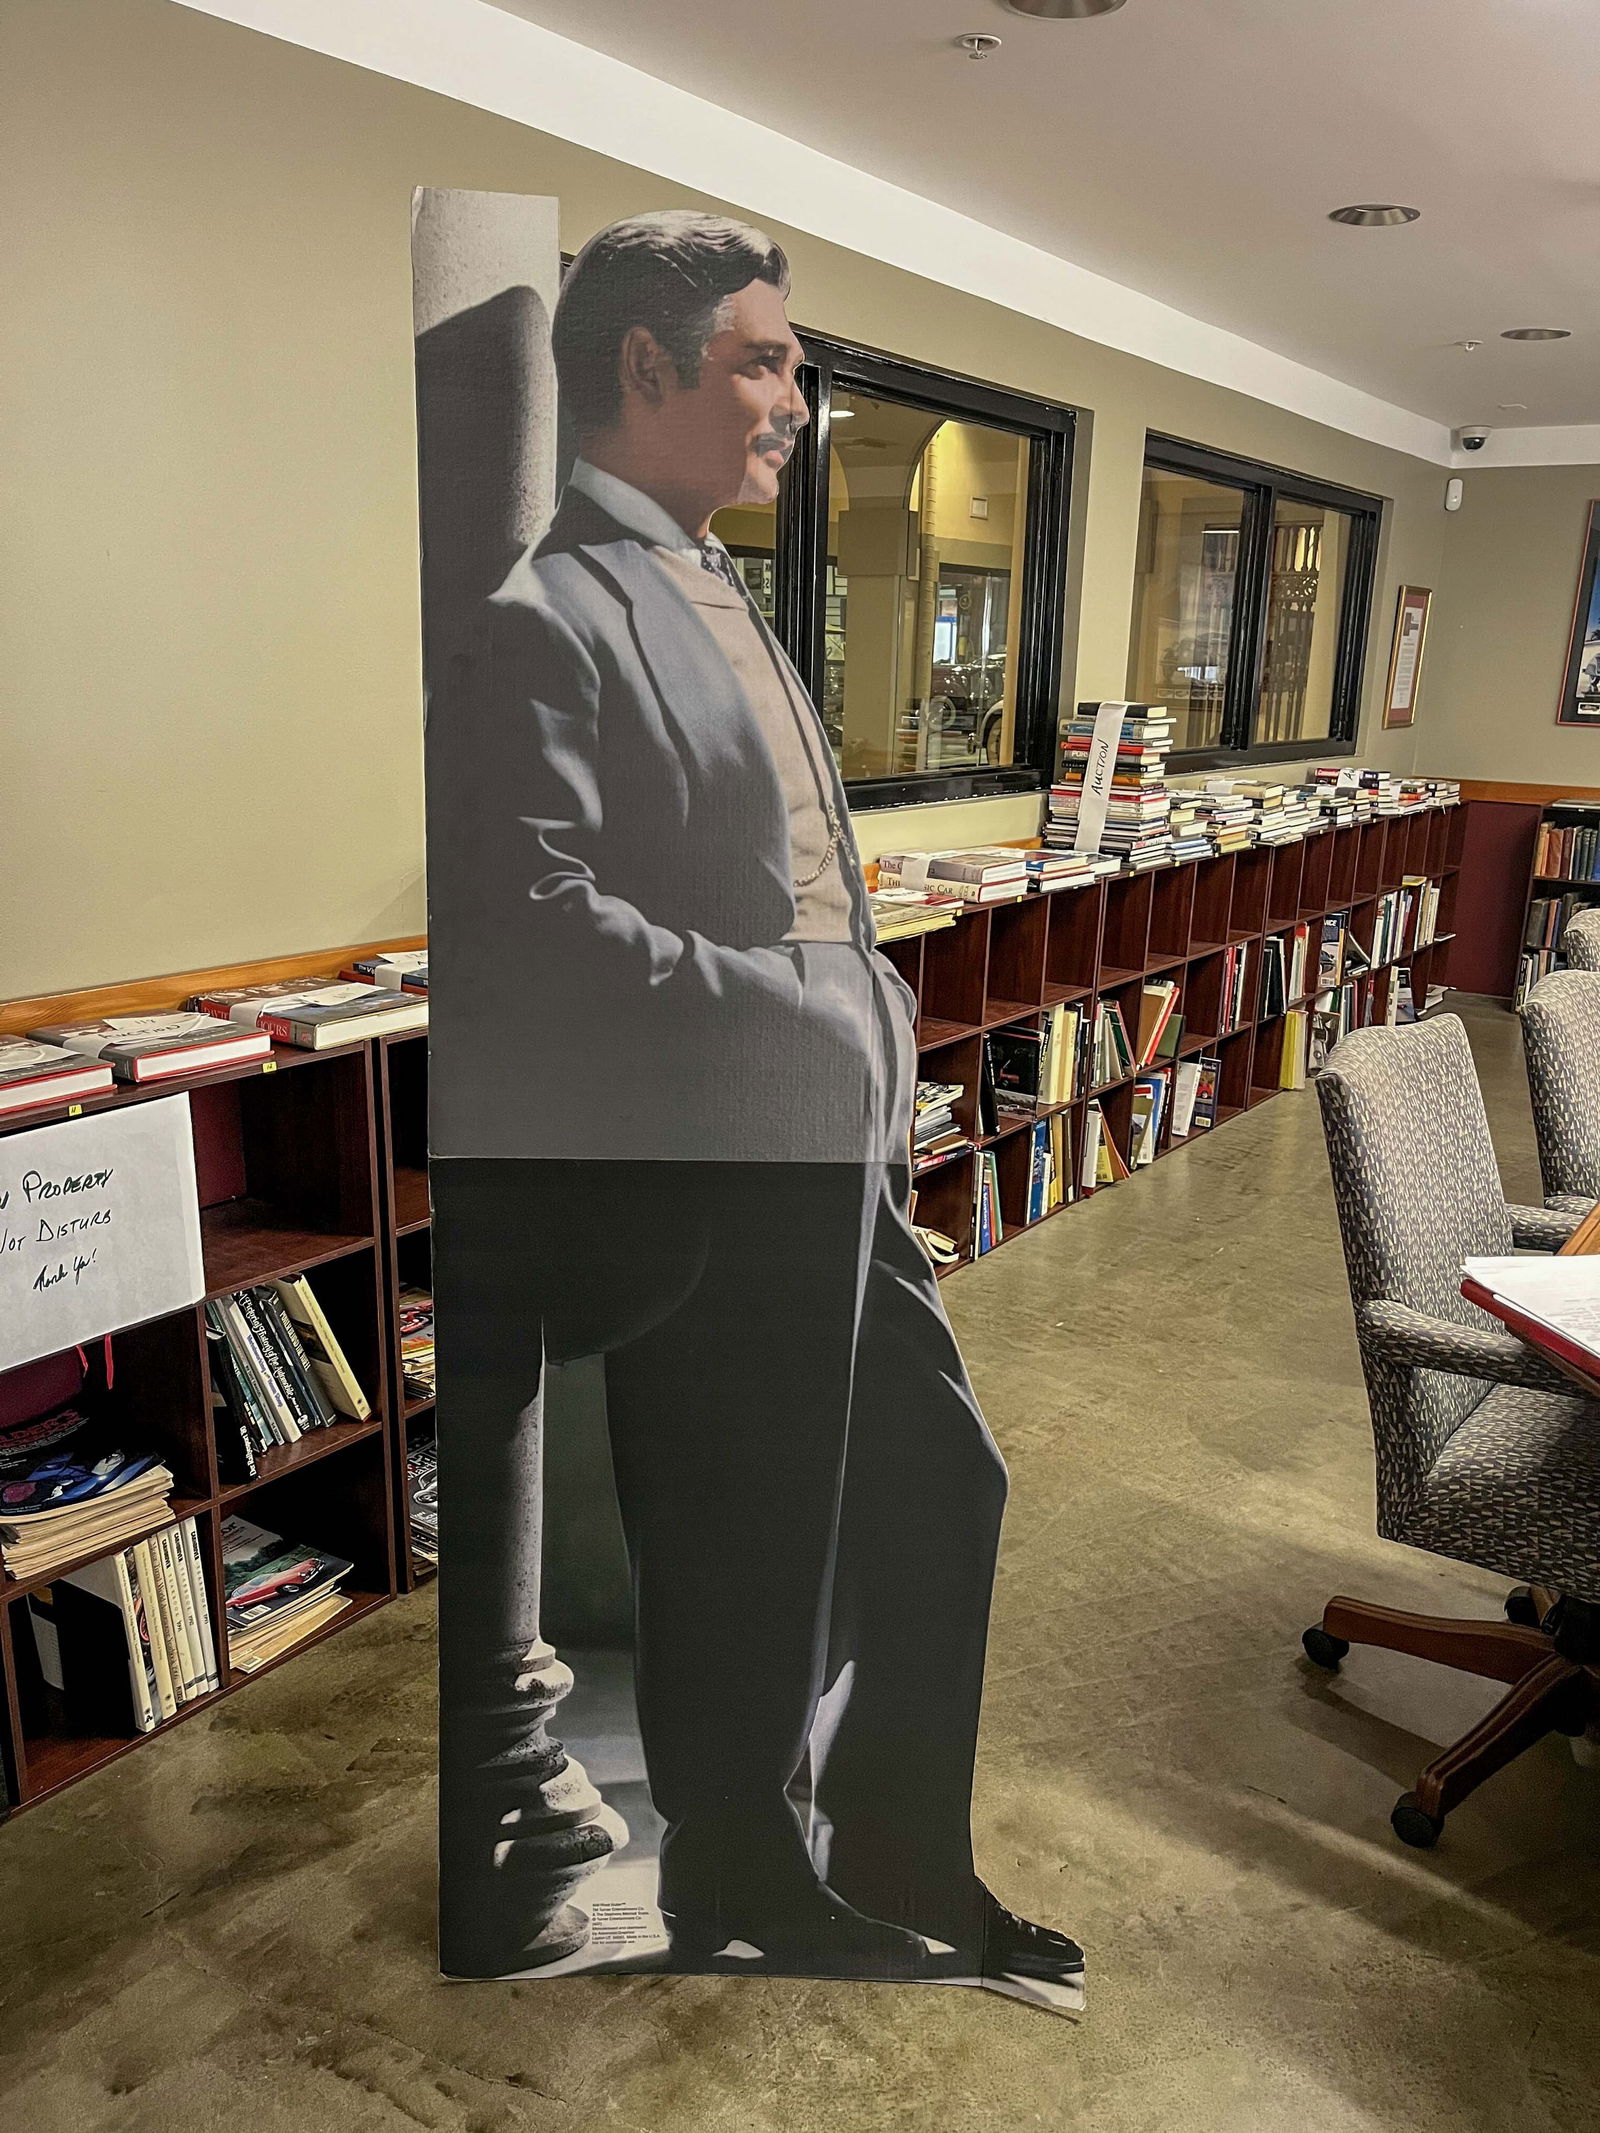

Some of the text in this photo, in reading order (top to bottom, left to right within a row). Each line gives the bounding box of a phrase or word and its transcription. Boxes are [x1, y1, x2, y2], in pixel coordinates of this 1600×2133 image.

[1090, 738, 1109, 796] AUCTION
[883, 860, 896, 869] The
[937, 884, 953, 895] CAR
[22, 1169, 114, 1203] PROPERTY
[36, 1209, 112, 1242] DISTURB
